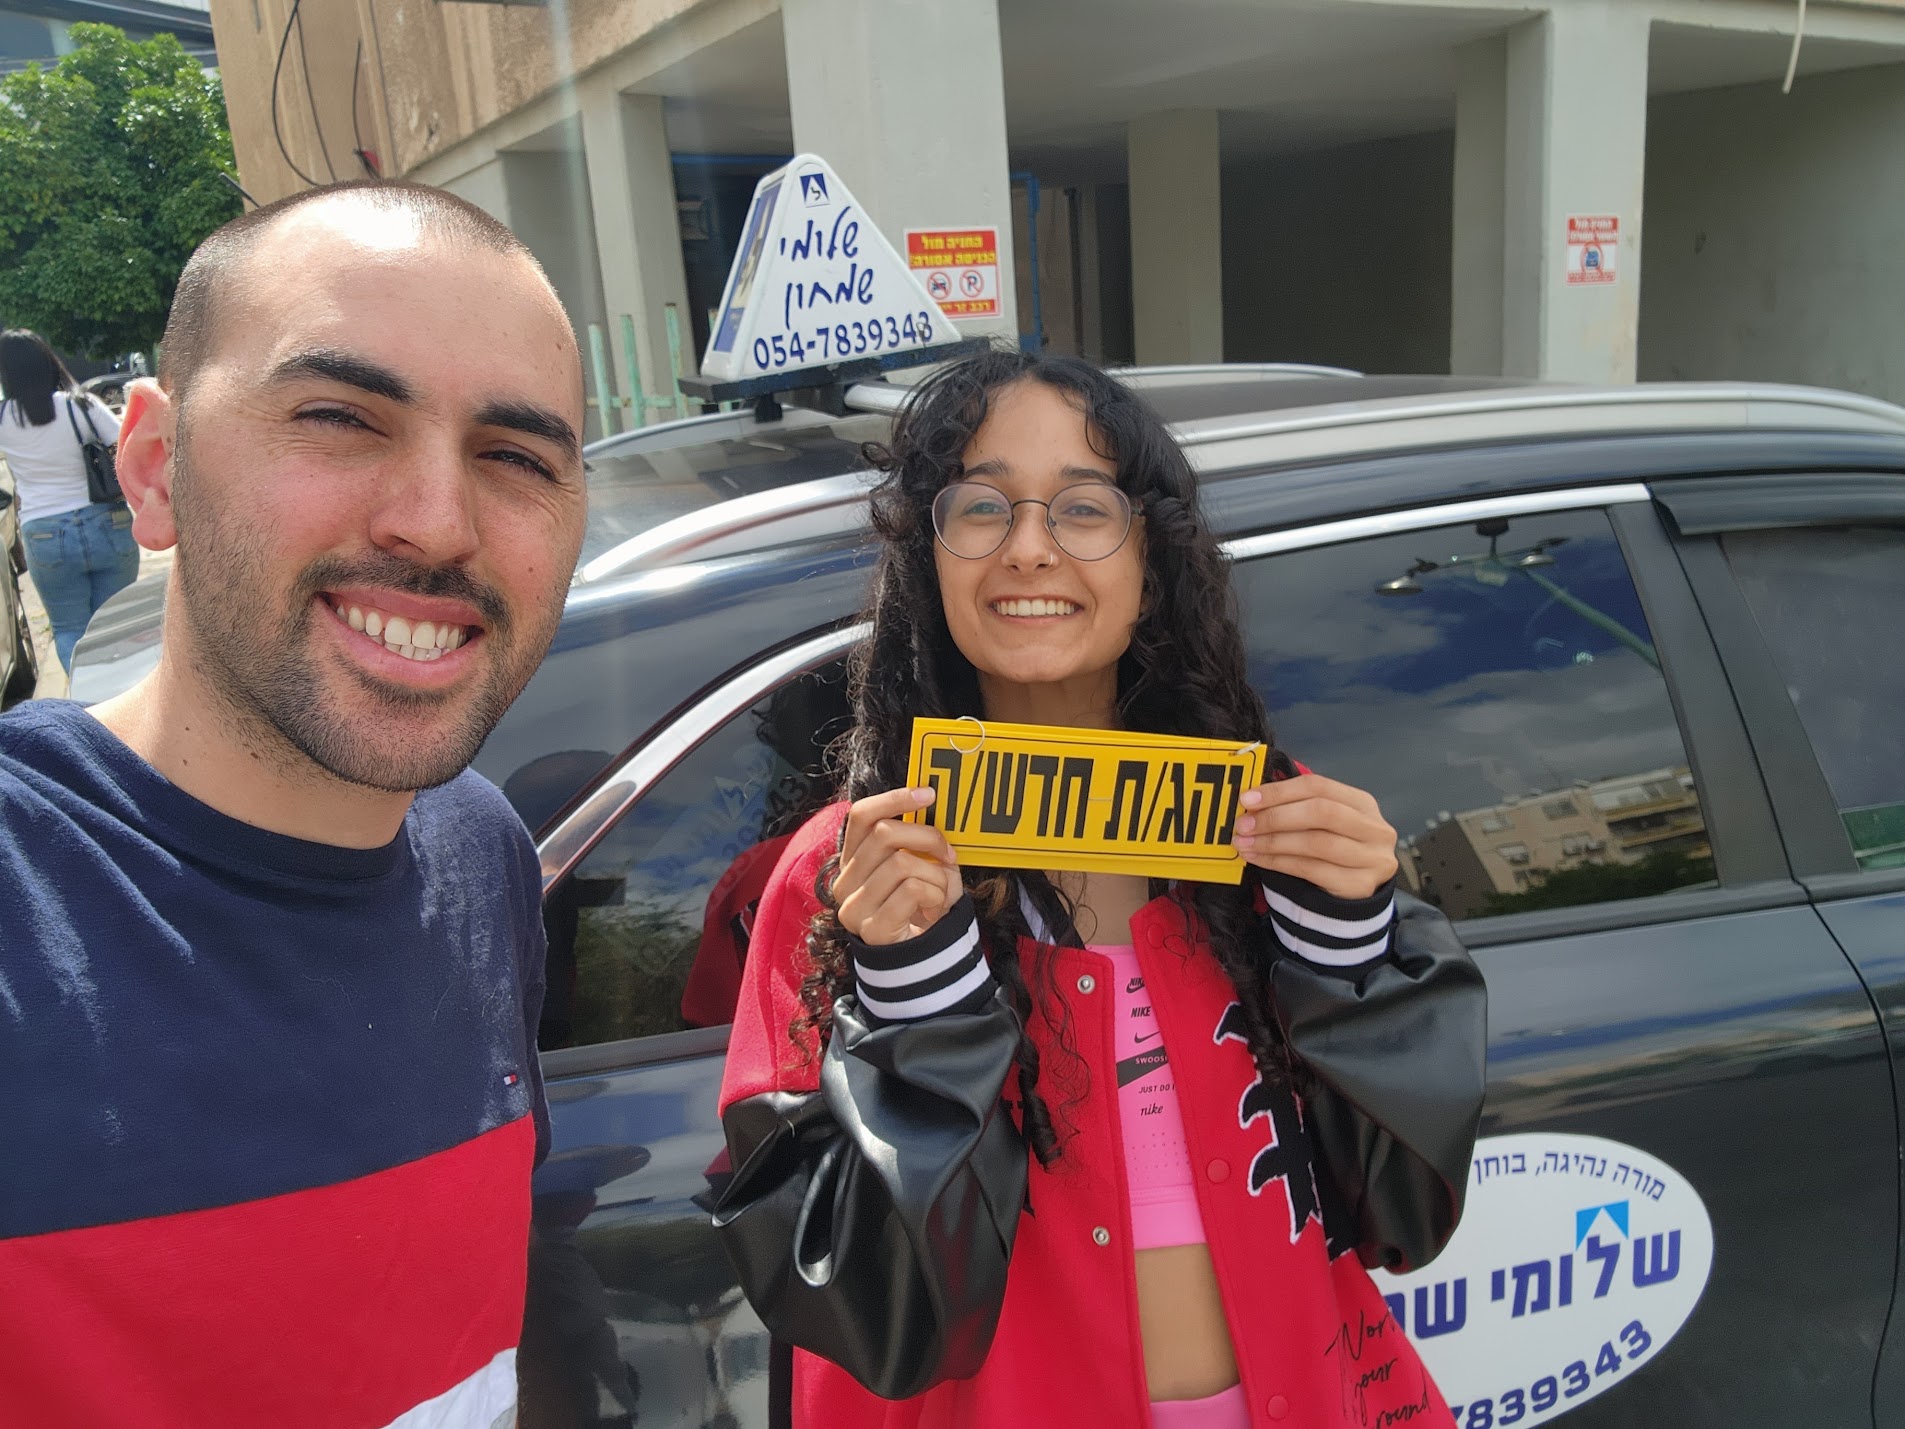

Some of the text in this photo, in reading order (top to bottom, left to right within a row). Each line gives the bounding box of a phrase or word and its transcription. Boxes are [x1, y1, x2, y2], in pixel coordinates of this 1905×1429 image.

[780, 206, 858, 261] שלומי
[921, 234, 945, 250] מול
[785, 263, 874, 331] שמחון
[754, 311, 934, 370] 054-7839343
[925, 748, 1245, 845] נהג/ת חדש/ה
[1130, 1006, 1151, 1018] NIKE
[1139, 1084, 1158, 1094] JUST
[1159, 1084, 1171, 1093] DO
[1140, 1102, 1164, 1117] nike
[1473, 1152, 1667, 1202] מורה נהיגה, בוחן
[1490, 1228, 1682, 1320] שלומי
